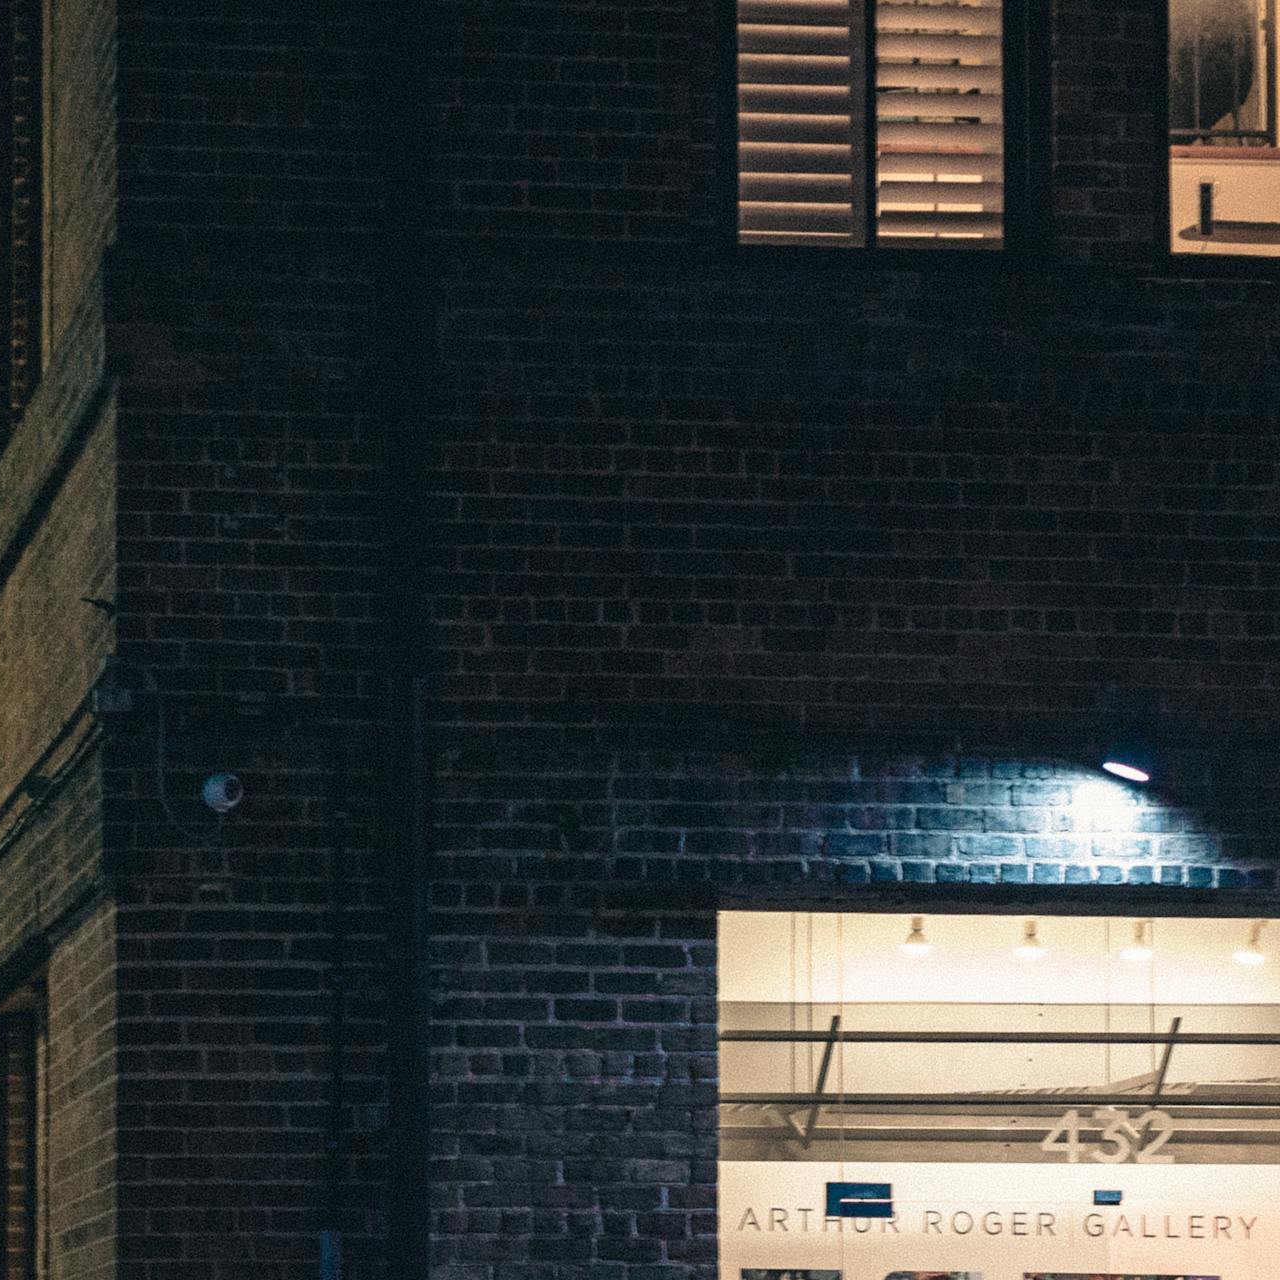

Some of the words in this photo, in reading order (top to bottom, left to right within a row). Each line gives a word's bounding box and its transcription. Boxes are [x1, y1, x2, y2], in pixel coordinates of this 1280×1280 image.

[1042, 1109, 1175, 1164] 432
[923, 1210, 1057, 1237] ROGER
[1082, 1212, 1259, 1240] GALLERY
